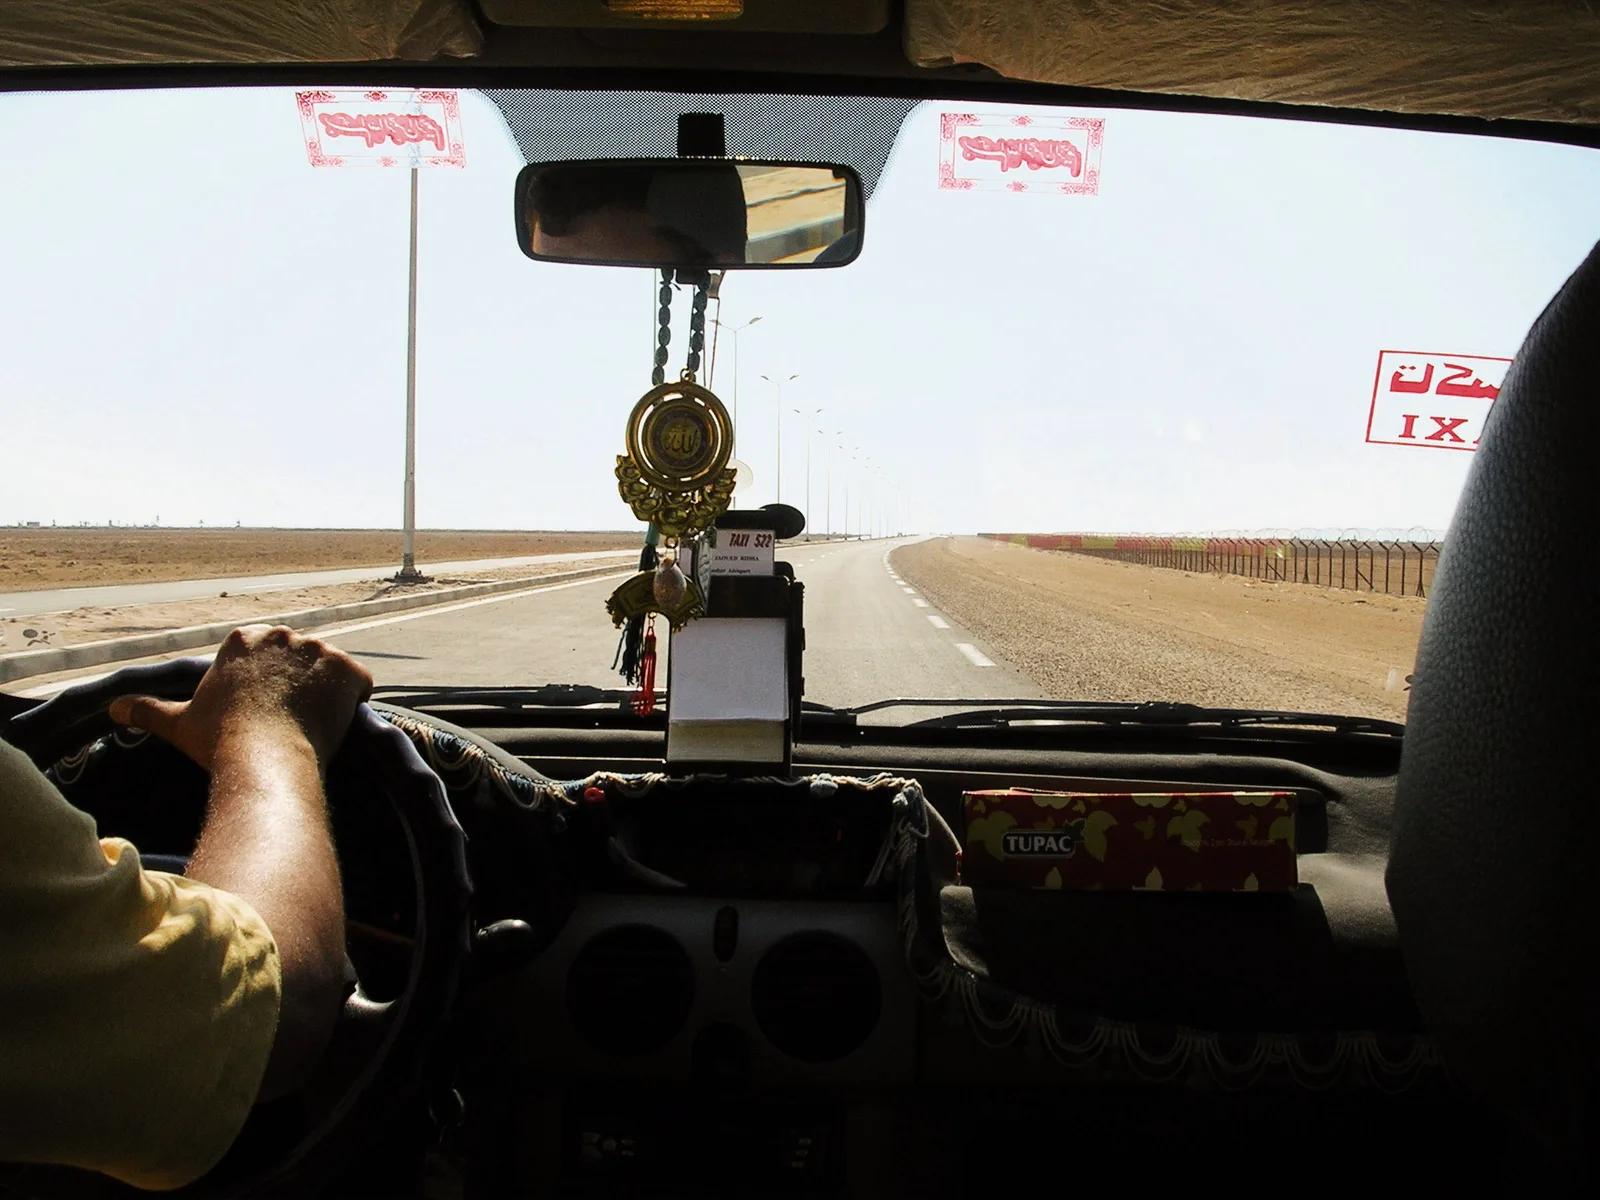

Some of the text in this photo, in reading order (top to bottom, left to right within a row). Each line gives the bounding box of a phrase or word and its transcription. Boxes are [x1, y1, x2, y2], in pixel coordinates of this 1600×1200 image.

[729, 533, 773, 548] TAXI 522
[1006, 835, 1071, 852] TUPAC
